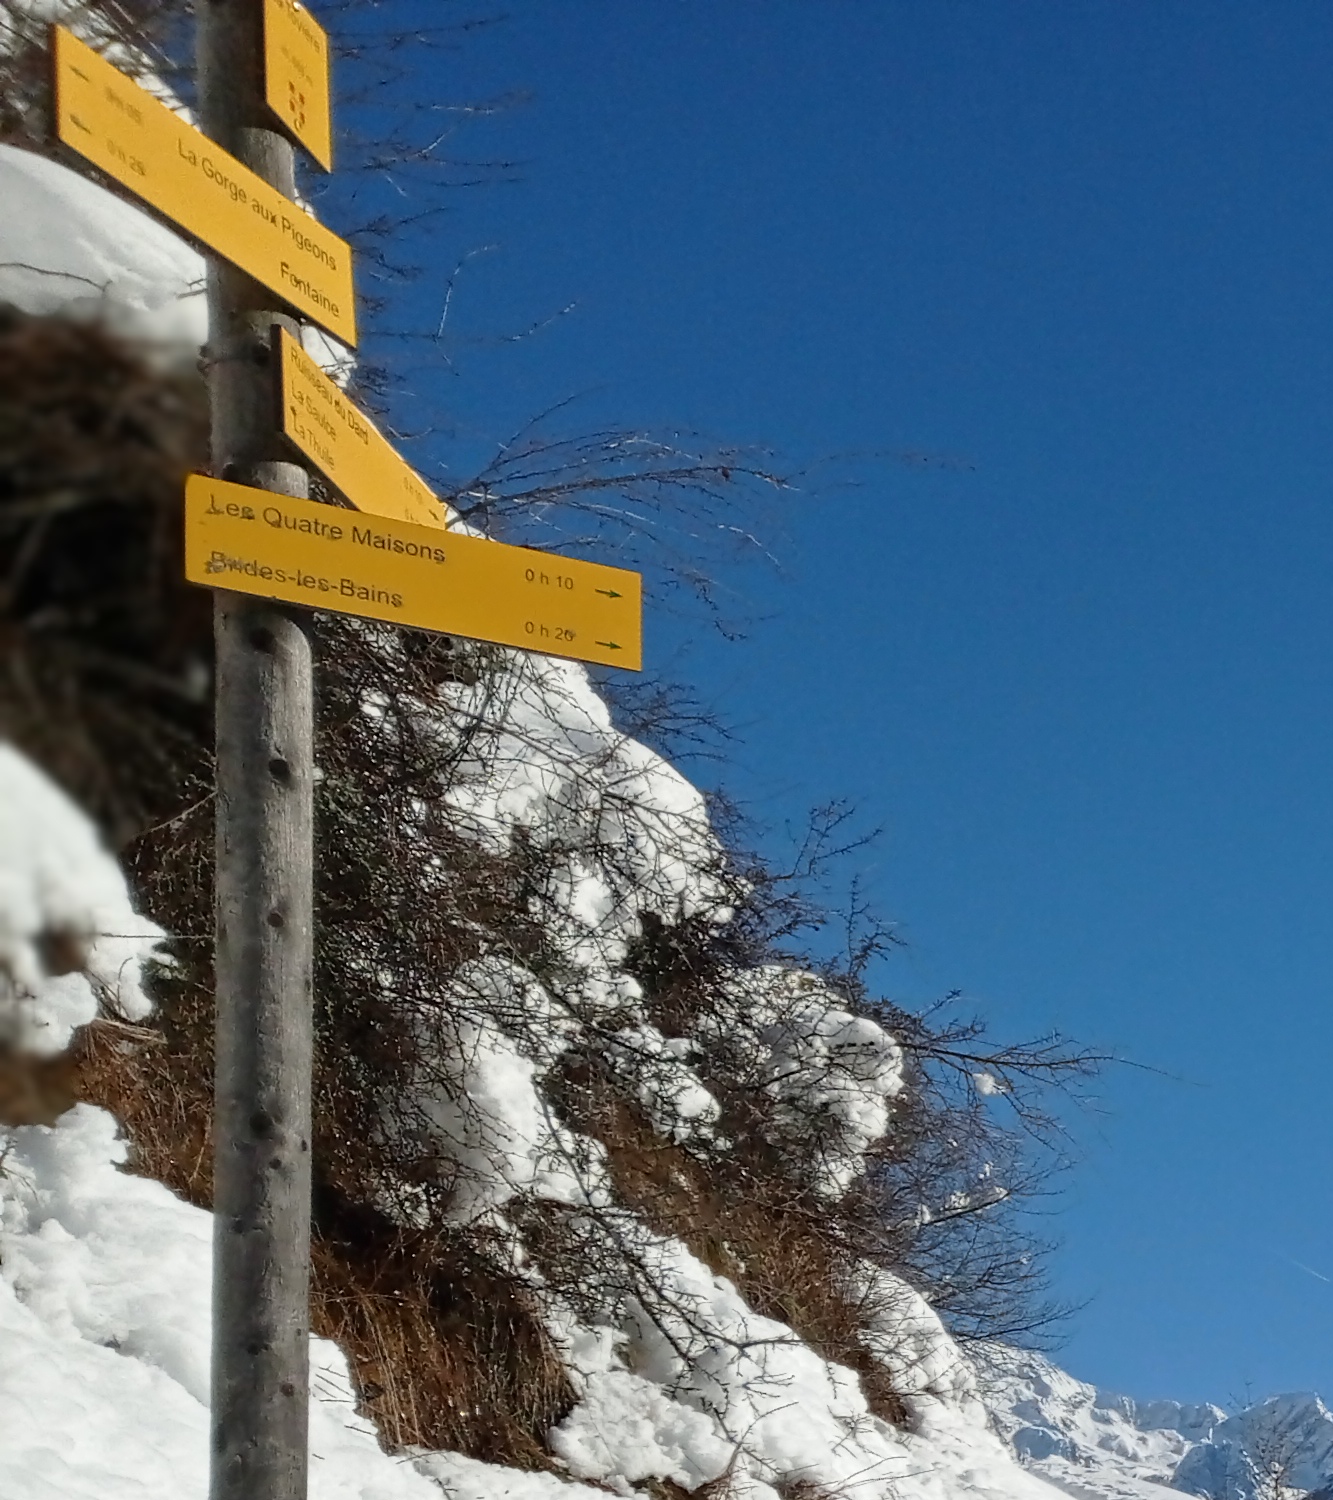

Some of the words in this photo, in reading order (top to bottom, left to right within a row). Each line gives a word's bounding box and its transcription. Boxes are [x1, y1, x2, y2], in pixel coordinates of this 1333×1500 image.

[178, 138, 198, 166] La
[202, 157, 247, 203] Gorge
[251, 199, 278, 228] aux
[281, 216, 337, 271] Pigeons
[280, 261, 340, 317] Fontaine
[291, 380, 304, 406] La
[334, 398, 346, 421] du
[293, 416, 305, 441] La
[208, 493, 255, 520] Les
[262, 506, 343, 540] Quatre
[352, 525, 446, 564] Maisons
[525, 568, 535, 582] 0
[540, 571, 549, 585] h
[556, 575, 574, 590] 10
[525, 621, 535, 634] 0
[540, 623, 549, 638] h
